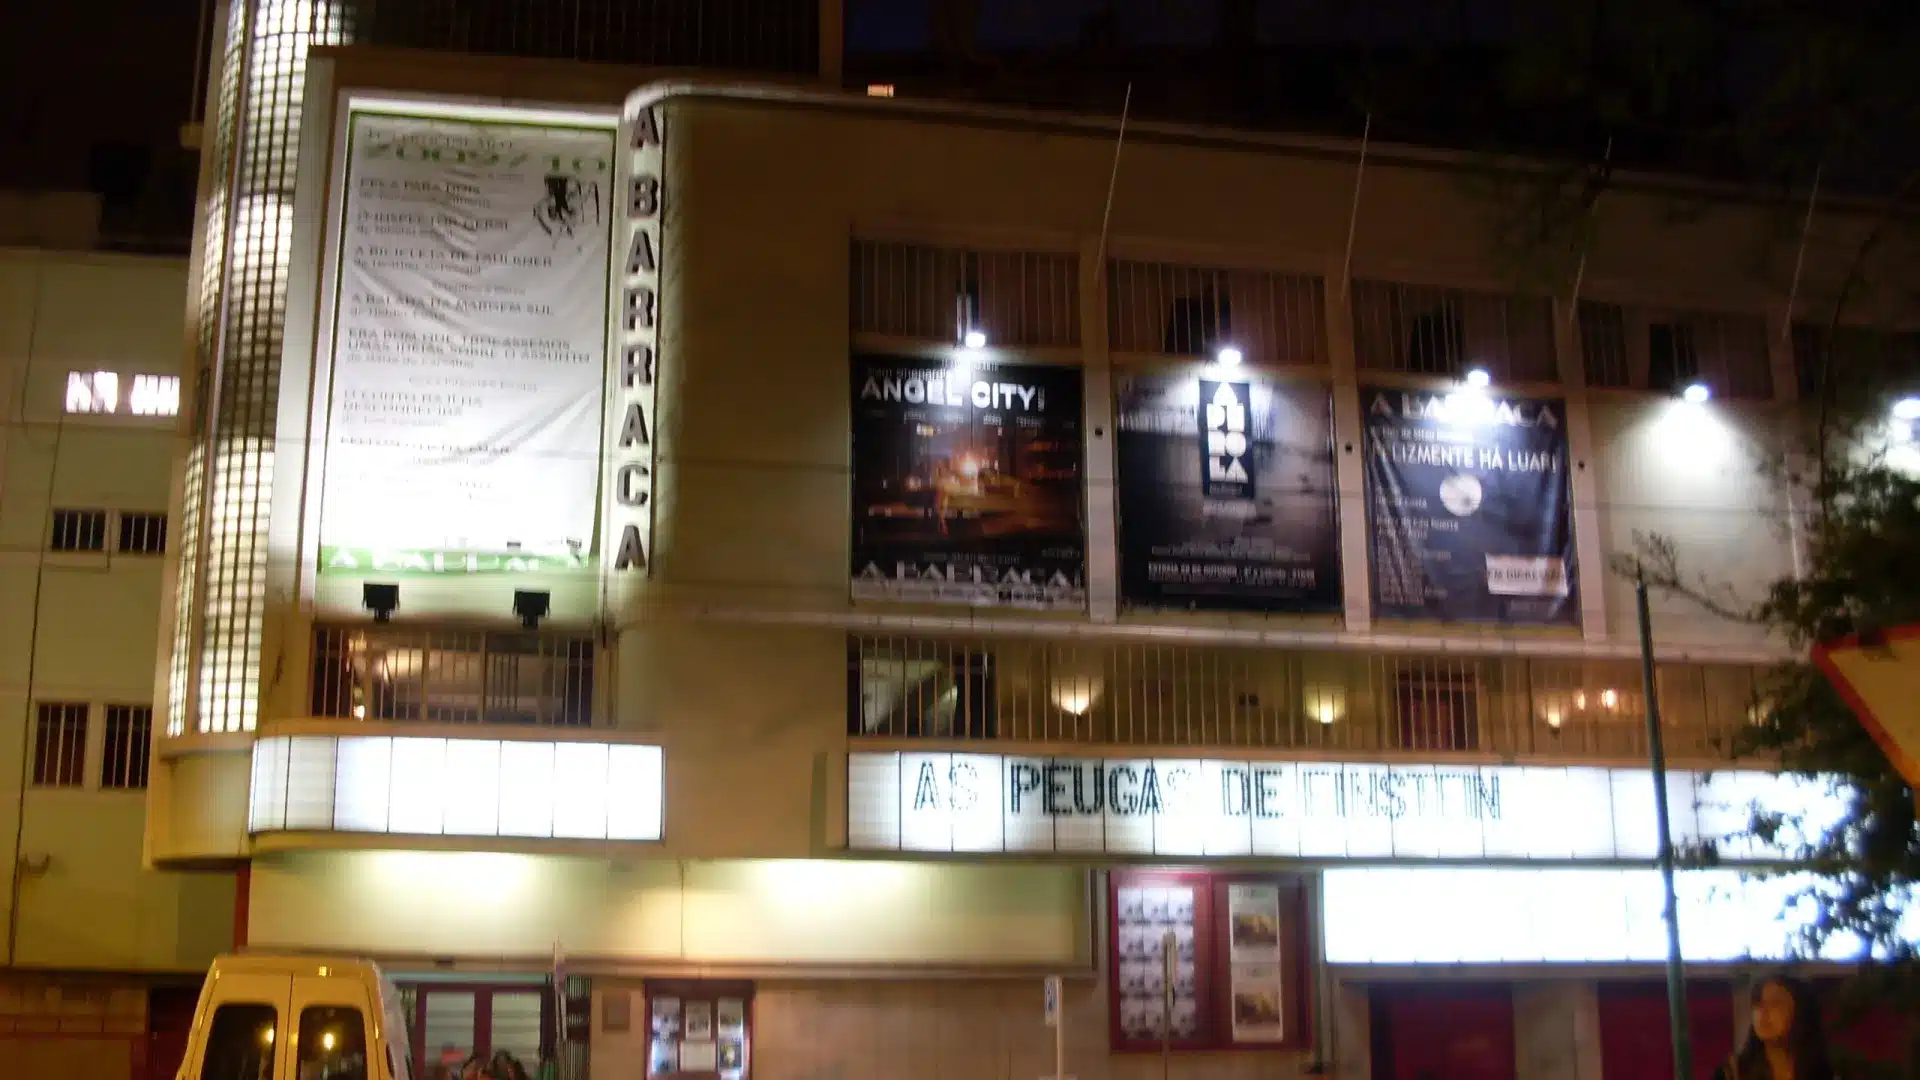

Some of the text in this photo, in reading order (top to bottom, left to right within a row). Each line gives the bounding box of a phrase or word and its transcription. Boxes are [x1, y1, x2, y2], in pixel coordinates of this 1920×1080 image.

[614, 105, 660, 571] A BARRACA
[861, 375, 964, 407] ANGEL
[971, 380, 1036, 412] CITY
[914, 760, 978, 811] AS
[1010, 761, 1192, 816] PEUGAS
[1221, 768, 1284, 819] DE
